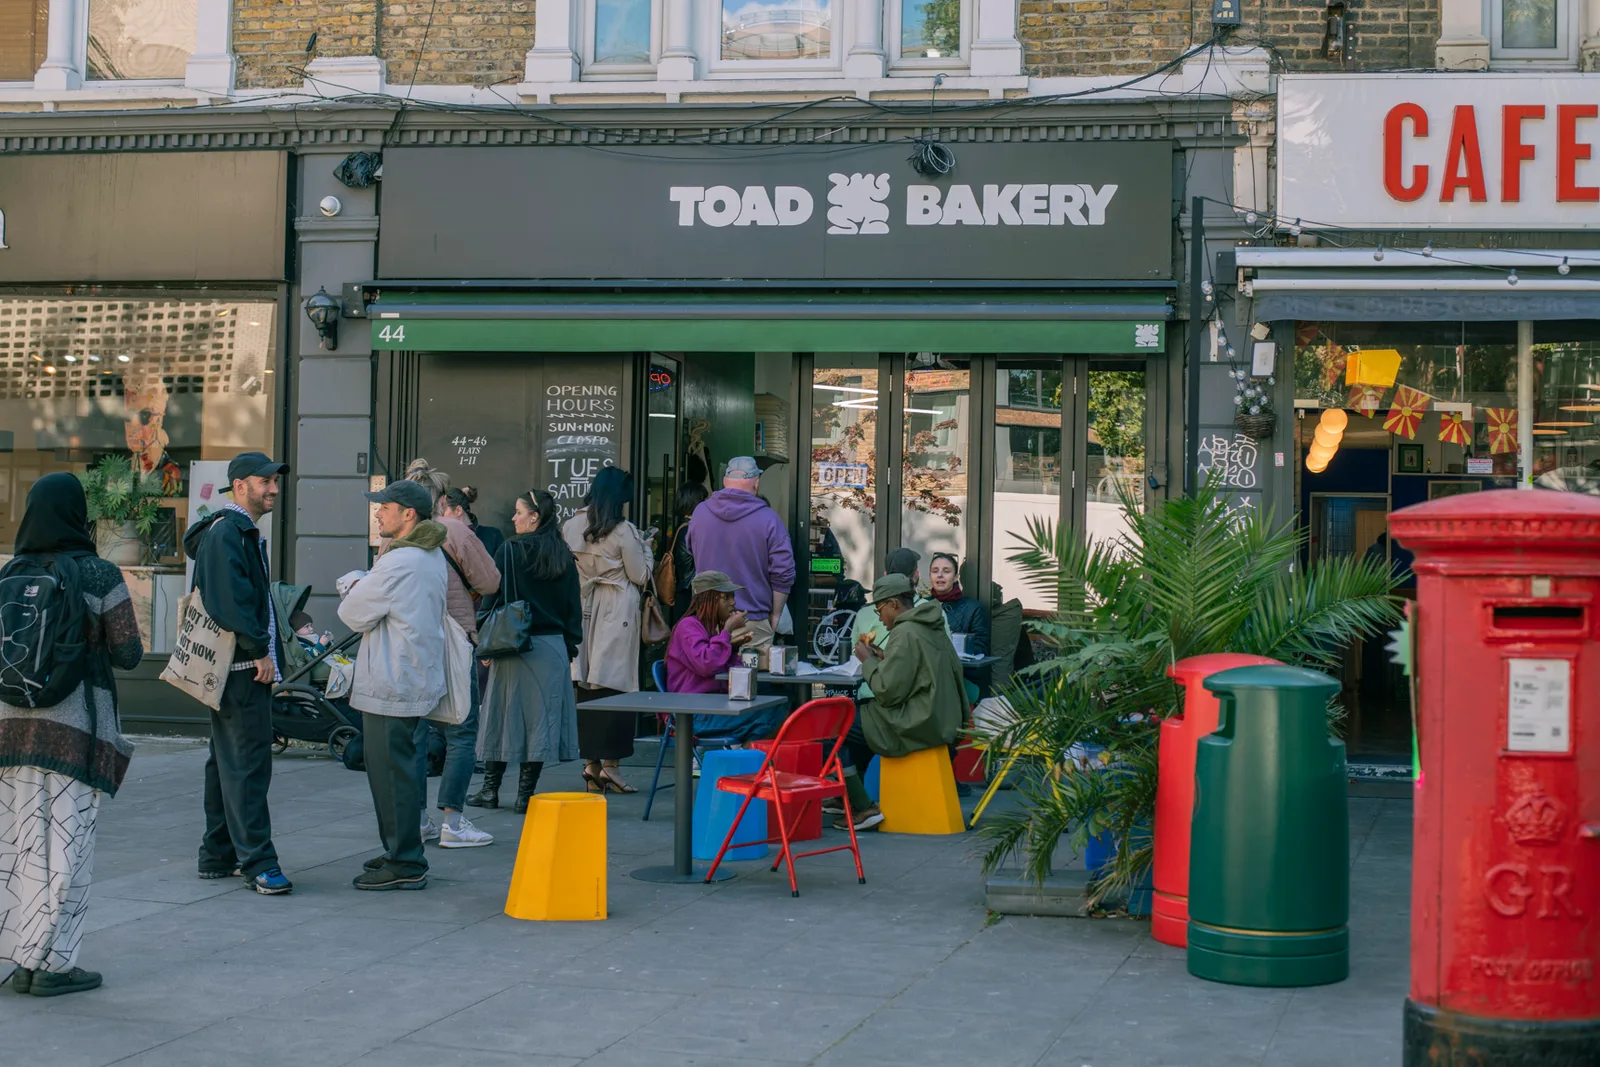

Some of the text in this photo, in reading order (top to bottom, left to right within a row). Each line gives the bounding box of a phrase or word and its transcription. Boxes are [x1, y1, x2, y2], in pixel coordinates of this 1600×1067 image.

[1383, 102, 1600, 202] CAFE
[670, 184, 1119, 227] TOAD BAKERY
[378, 324, 406, 343] 44
[905, 374, 952, 387] OPEN
[546, 385, 617, 396] OPENING
[546, 399, 615, 411] HOURS
[451, 435, 487, 446] 44-46
[557, 435, 608, 445] CLOSED
[457, 446, 481, 455] FLATS
[823, 467, 864, 484] OPEN
[191, 642, 216, 665] NOW,
